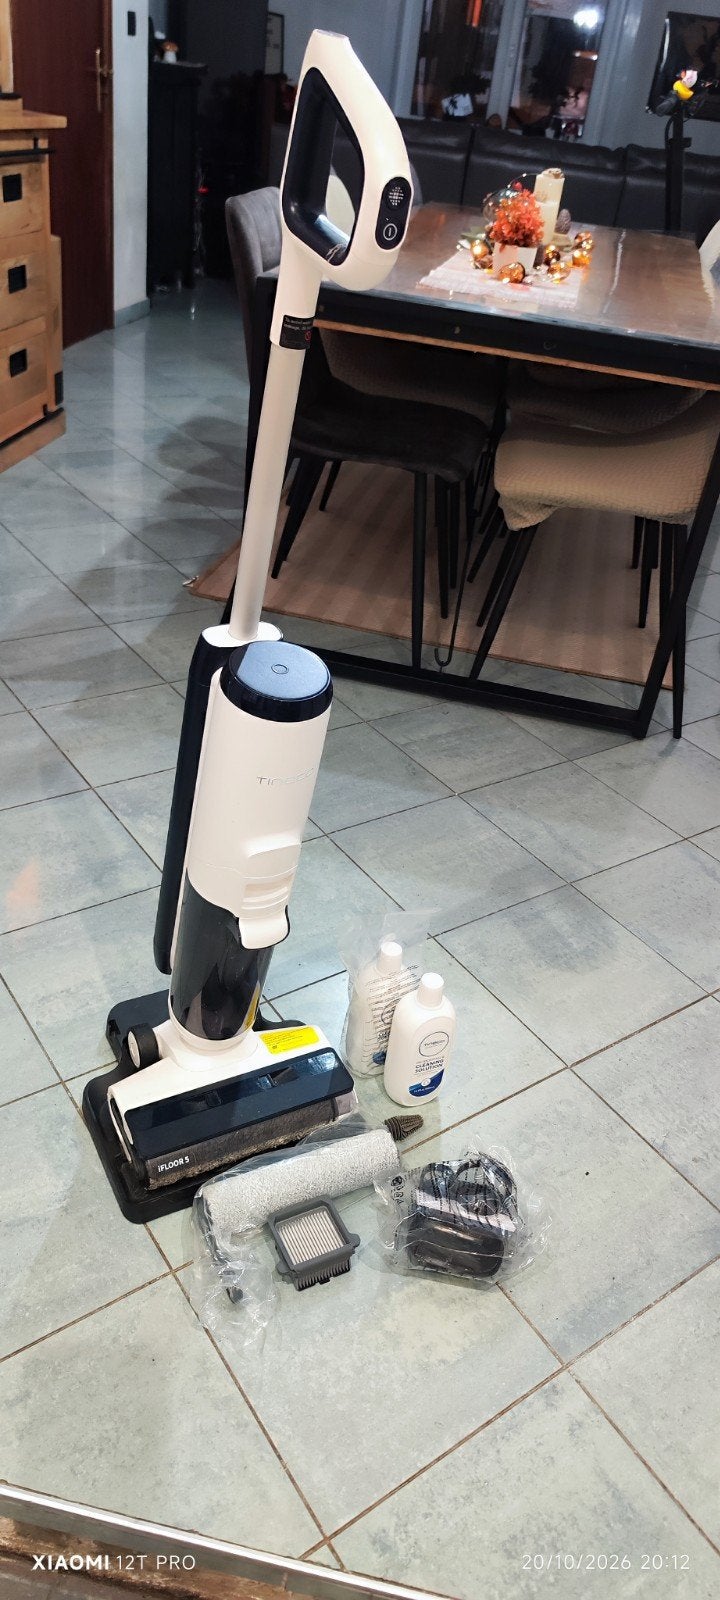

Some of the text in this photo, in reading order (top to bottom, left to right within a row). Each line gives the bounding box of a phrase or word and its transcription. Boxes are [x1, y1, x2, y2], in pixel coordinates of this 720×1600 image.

[414, 1063, 443, 1073] SOLUTION
[415, 1058, 444, 1069] CLEANING
[157, 1155, 190, 1173] iFLOOR 5
